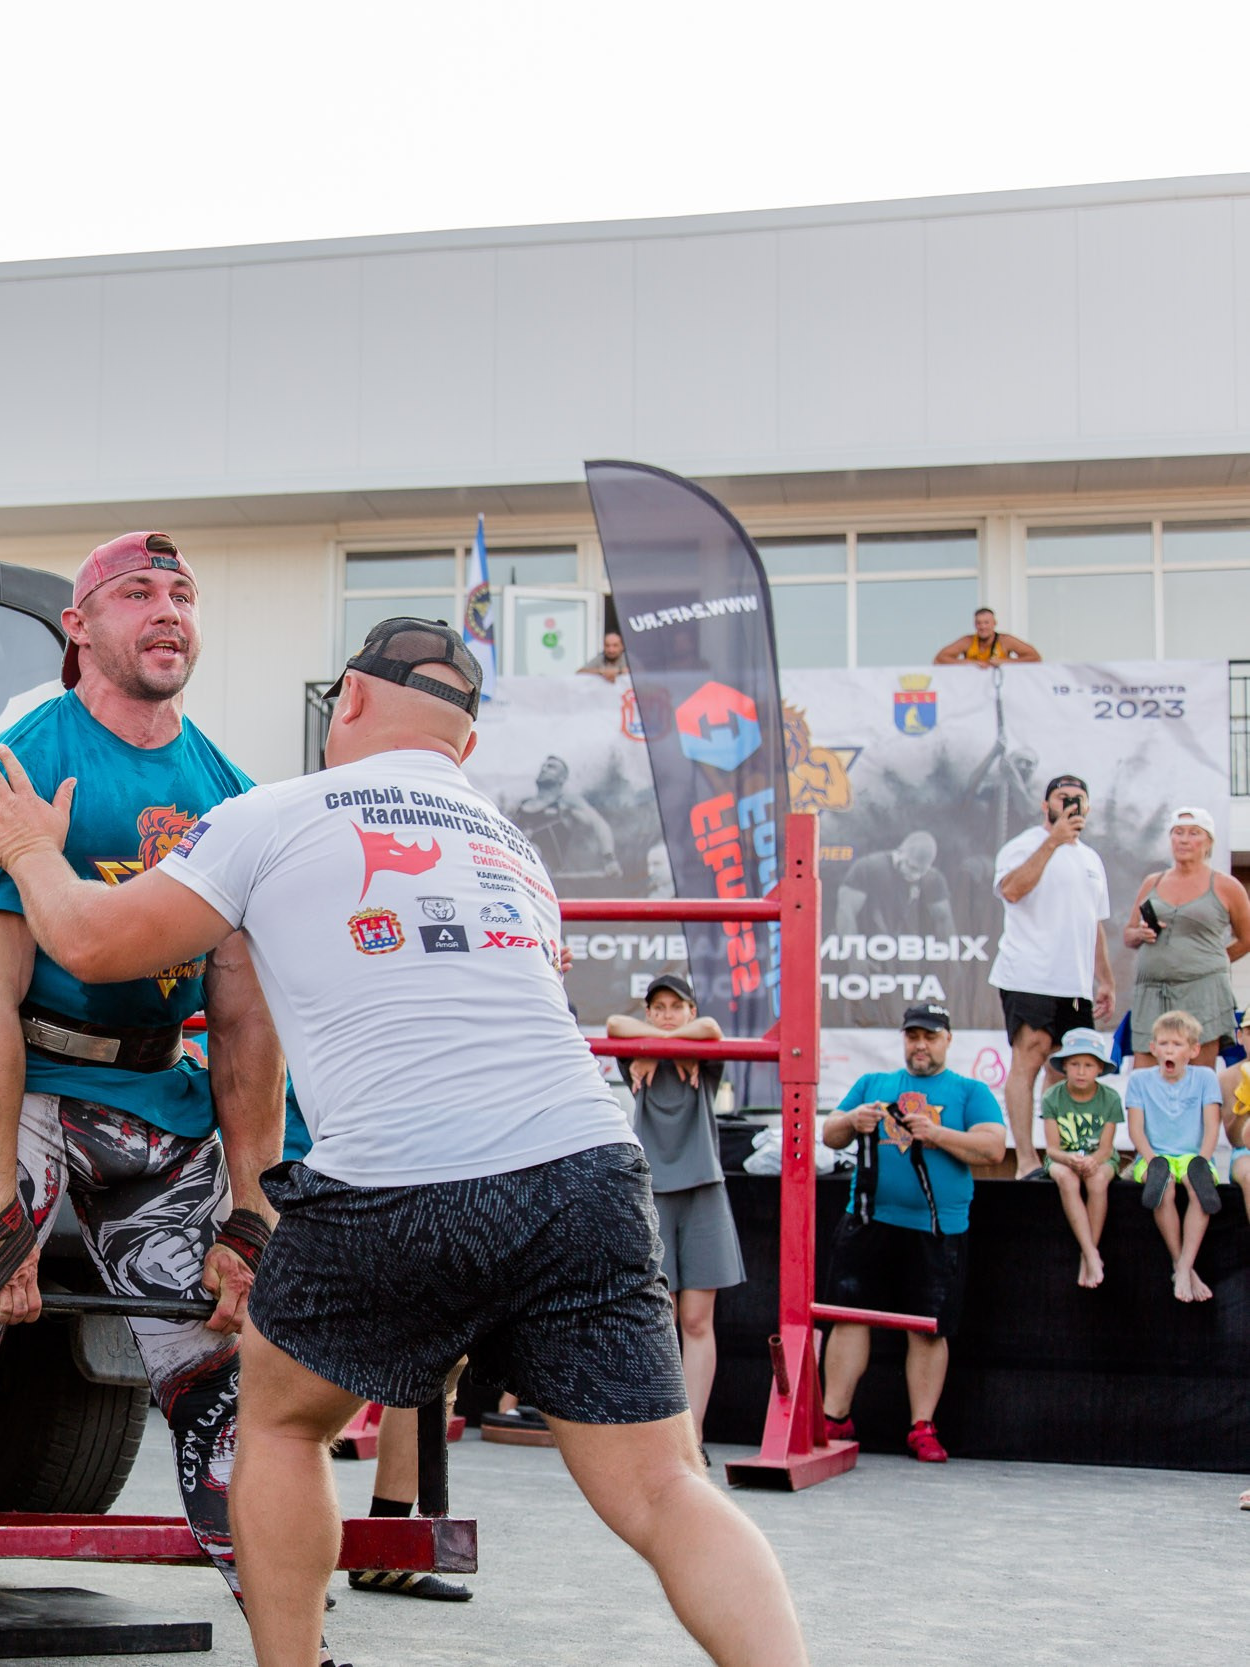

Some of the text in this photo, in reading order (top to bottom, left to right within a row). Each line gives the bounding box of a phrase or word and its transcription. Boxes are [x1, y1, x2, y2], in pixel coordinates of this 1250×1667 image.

[1119, 684, 1187, 697] августа
[1093, 699, 1186, 719] 2023
[820, 934, 990, 962] ИЛОВЫХ
[820, 973, 947, 1001] ПОРТА
